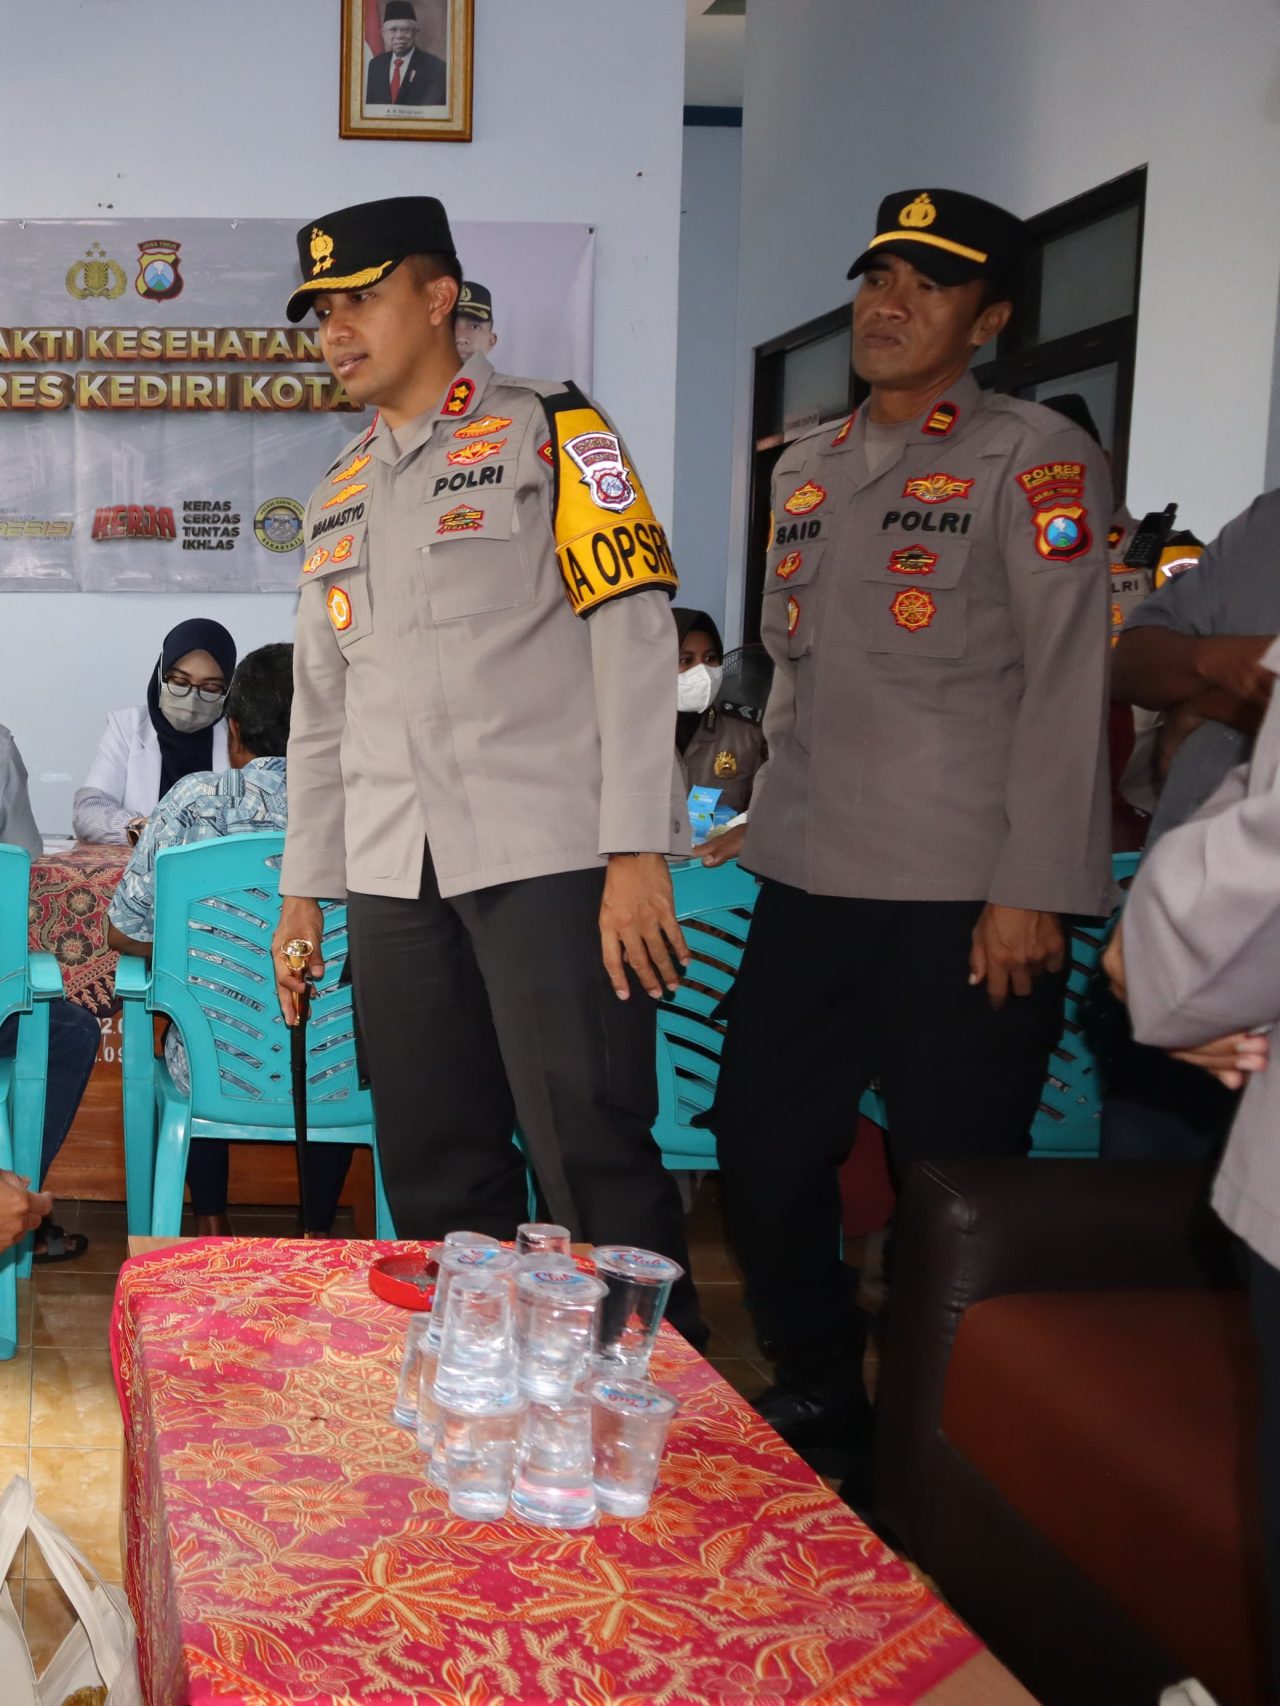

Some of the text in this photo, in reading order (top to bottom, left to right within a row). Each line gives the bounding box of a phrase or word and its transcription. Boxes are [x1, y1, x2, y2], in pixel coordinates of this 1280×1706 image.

[87, 328, 322, 361] KESEHATAN
[77, 373, 228, 409] KEDIRI
[432, 465, 504, 497] POLRI
[1022, 464, 1081, 488] POLRES
[183, 500, 232, 511] KERAS
[92, 504, 177, 541] KERJA
[183, 514, 241, 524] CERDAS
[882, 511, 972, 534] POLRI
[183, 527, 240, 537] TUNTAS
[776, 520, 821, 545] SAID
[182, 540, 235, 550] IKHLAS
[535, 1271, 574, 1282] Club
